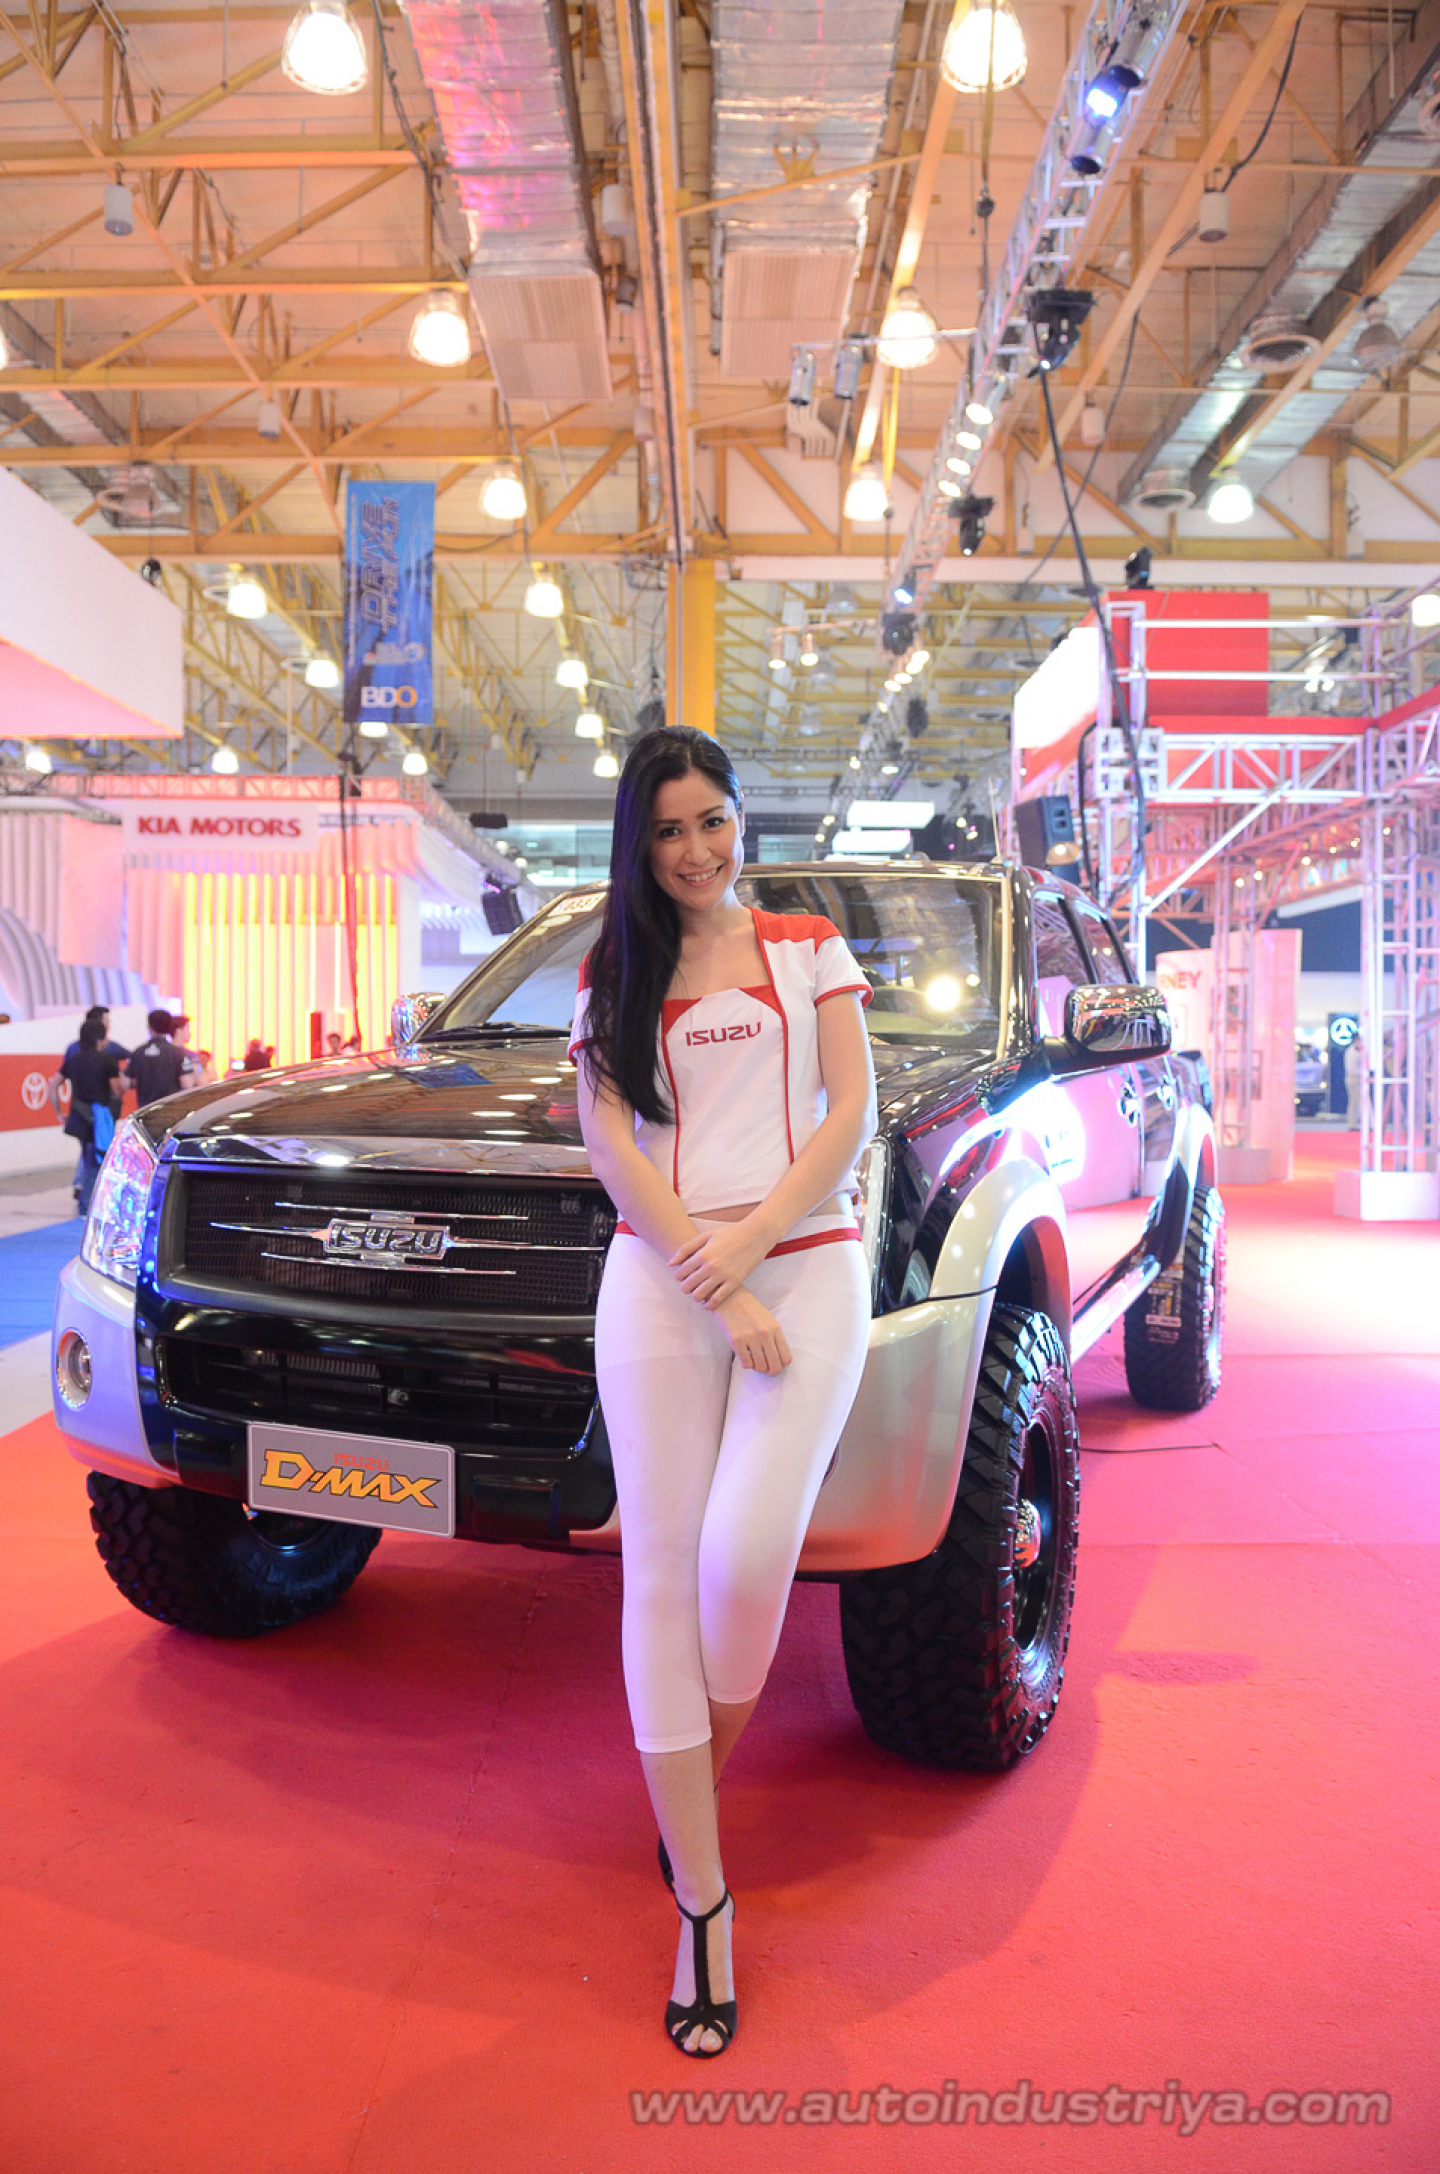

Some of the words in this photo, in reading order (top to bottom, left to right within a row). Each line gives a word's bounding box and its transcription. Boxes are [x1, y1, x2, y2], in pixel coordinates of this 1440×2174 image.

[361, 500, 383, 624] DRIVE
[361, 686, 418, 708] BDO
[137, 816, 181, 835] KIA
[190, 816, 302, 838] MOTORS
[684, 1021, 762, 1047] ISUZU
[330, 1225, 443, 1254] ISUZU
[333, 1452, 389, 1472] ISUZU
[259, 1449, 443, 1509] D-MAX
